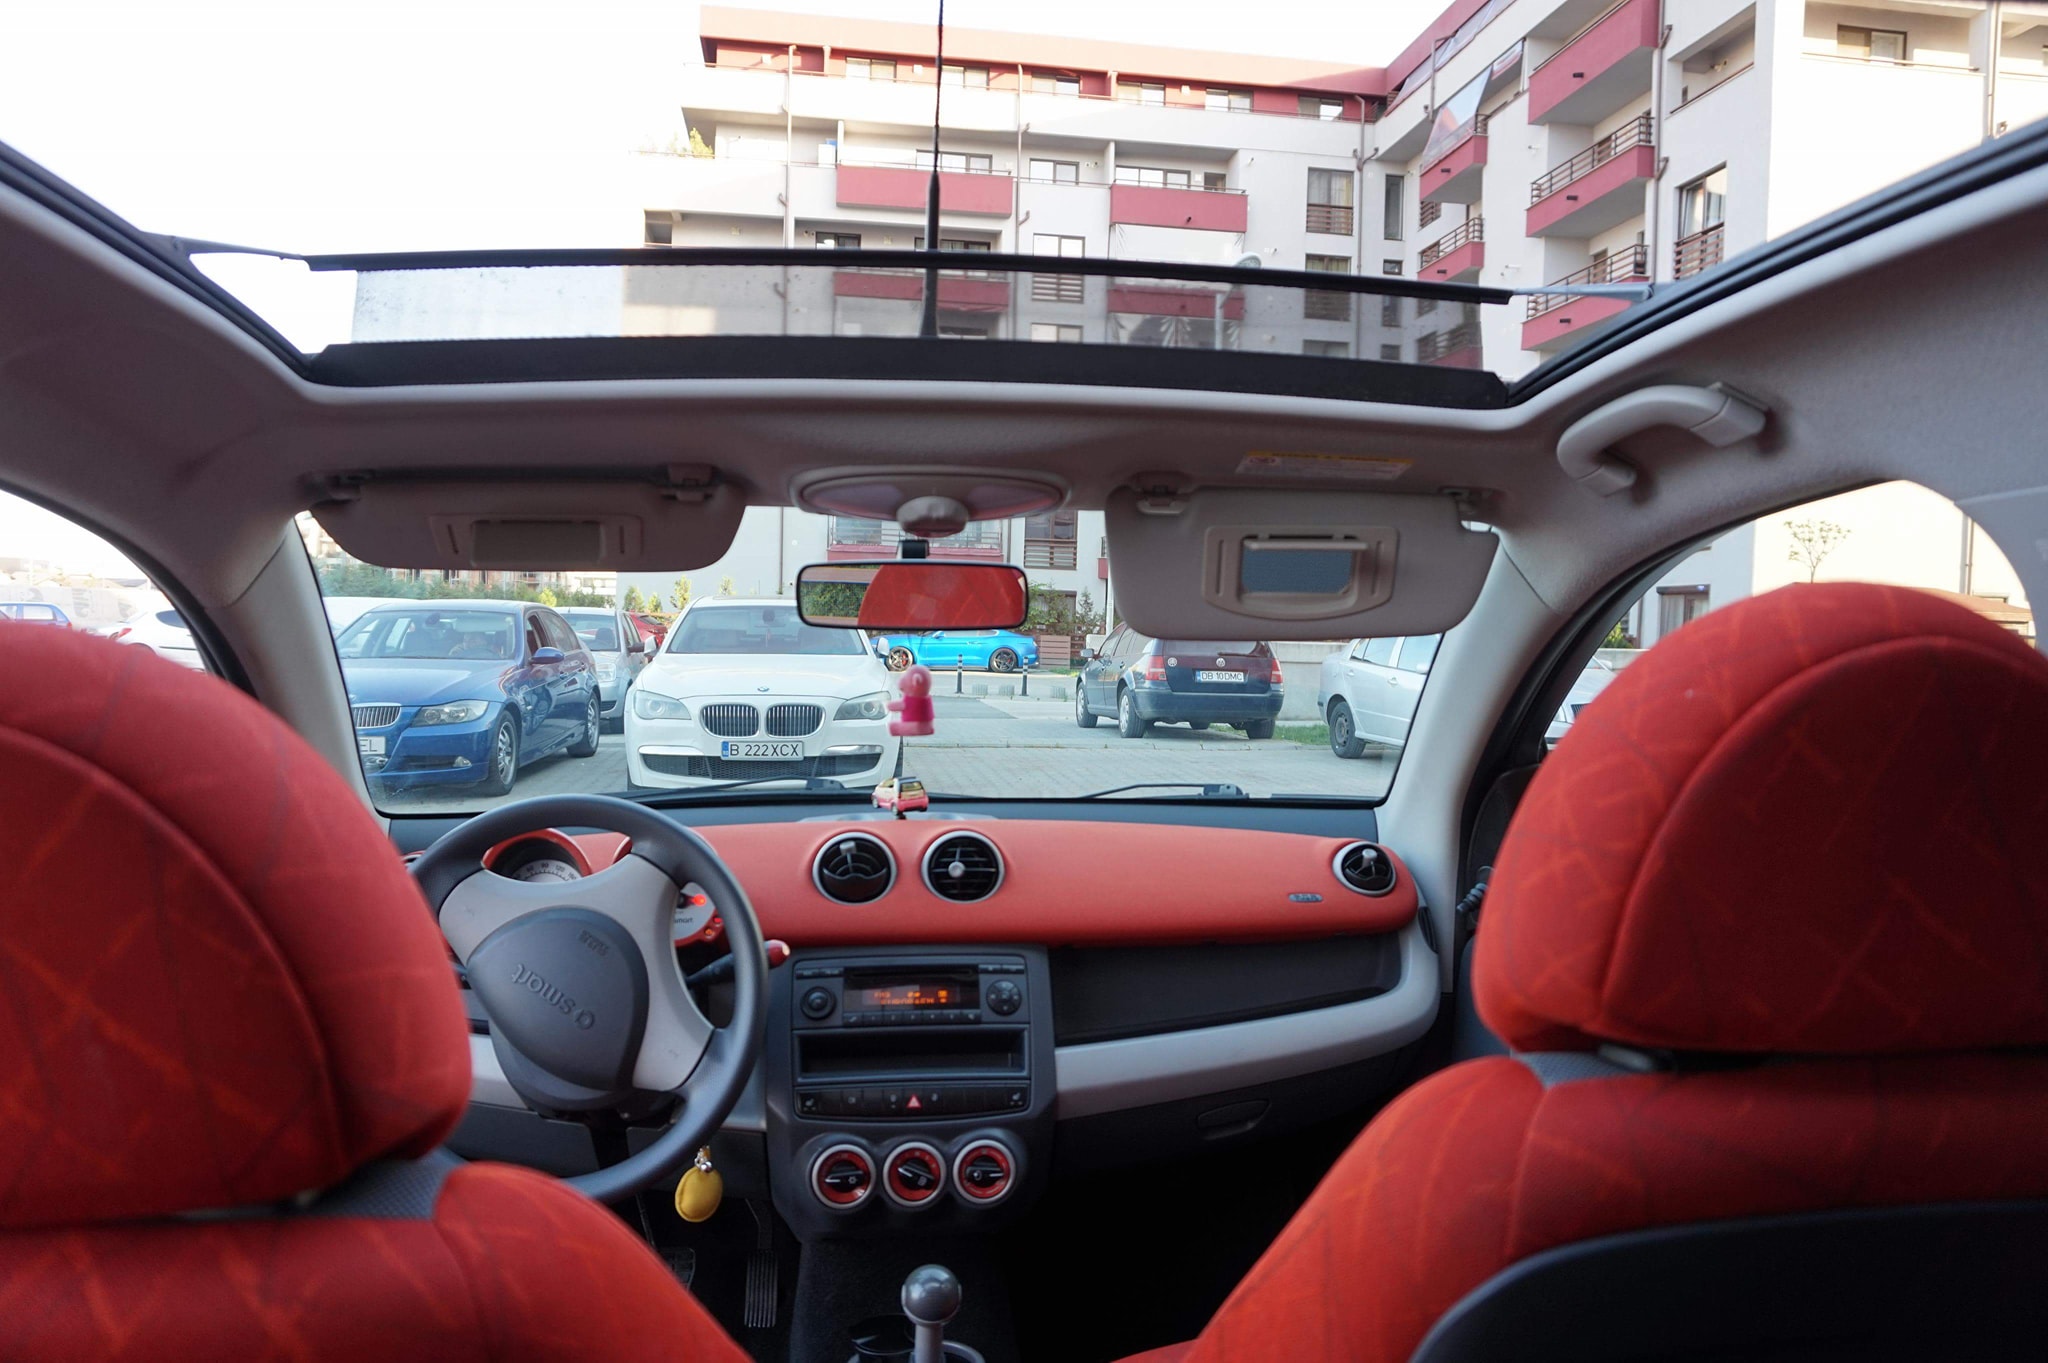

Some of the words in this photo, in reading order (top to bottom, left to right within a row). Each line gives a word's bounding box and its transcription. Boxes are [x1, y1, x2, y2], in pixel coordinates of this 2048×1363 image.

[1201, 672, 1214, 680] DB
[730, 743, 740, 756] B
[511, 963, 577, 1015] smart
